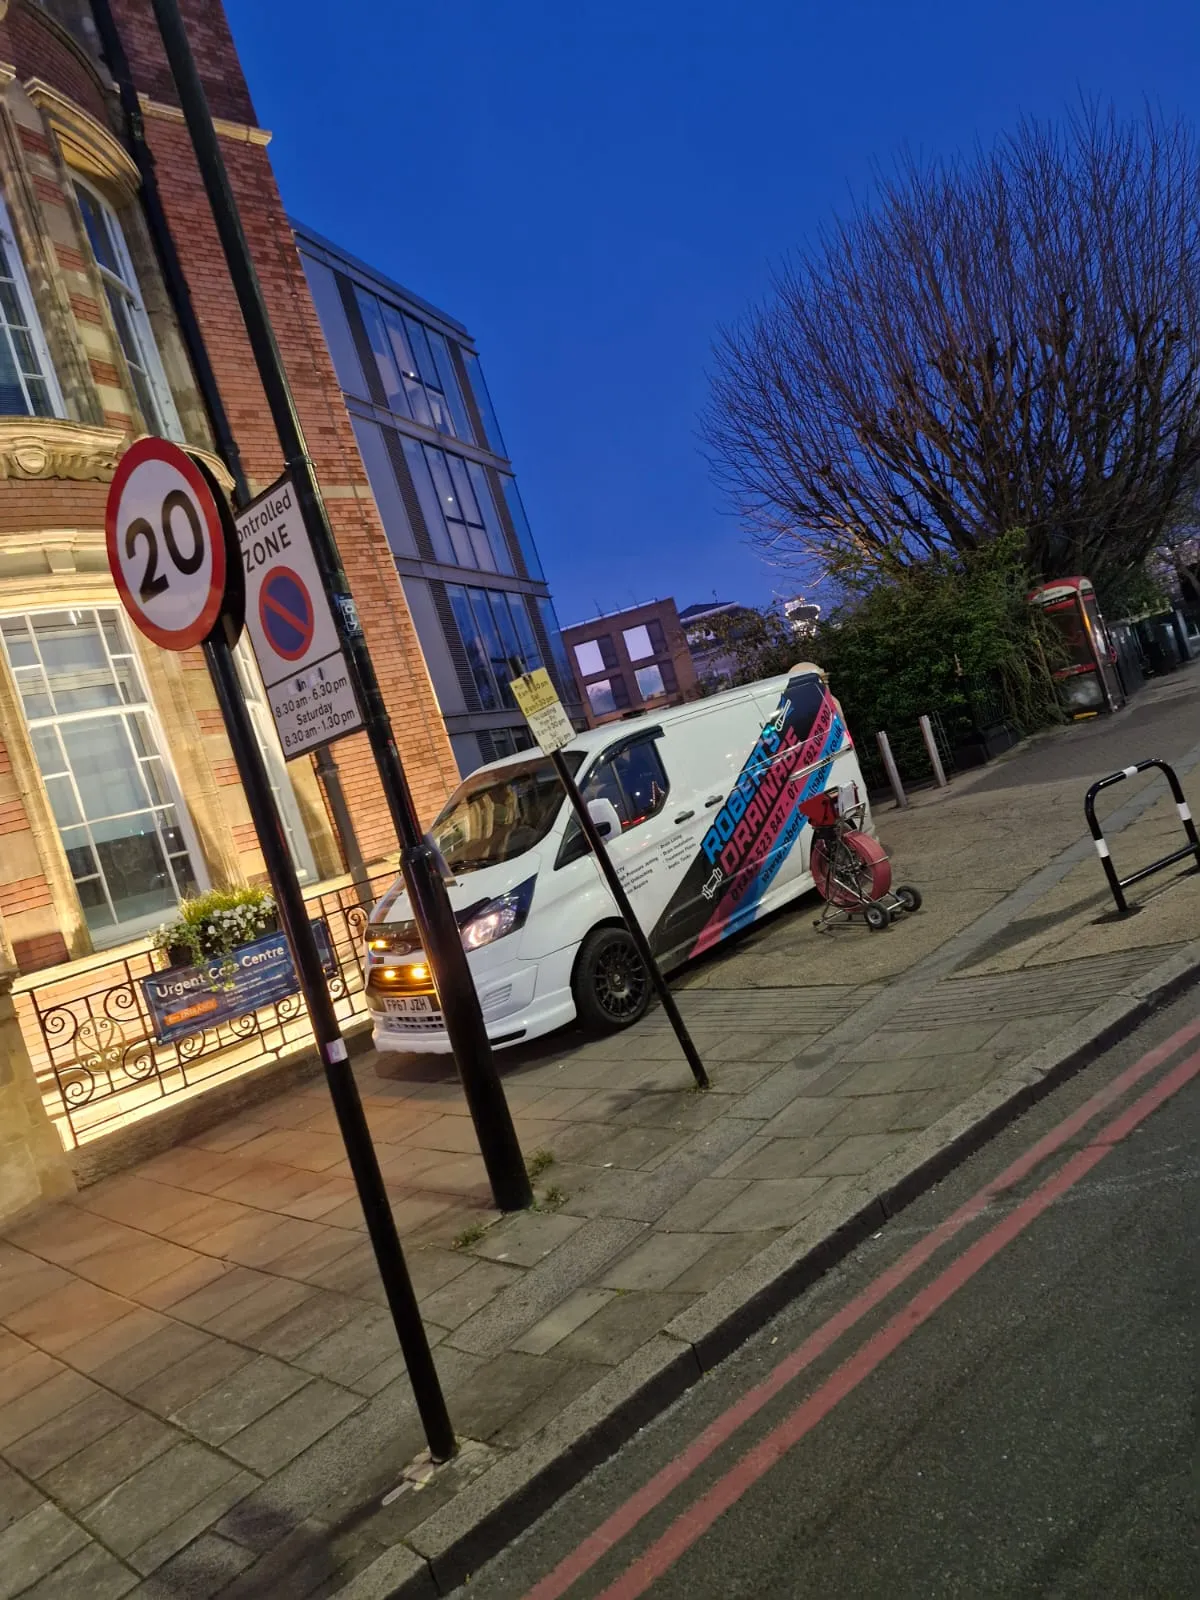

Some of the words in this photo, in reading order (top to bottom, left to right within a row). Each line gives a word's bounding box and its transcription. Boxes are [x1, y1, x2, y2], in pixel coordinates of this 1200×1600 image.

[237, 488, 292, 543] ontrolled
[125, 489, 205, 604] 20
[242, 523, 292, 573] ZONE
[296, 702, 333, 726] Saturday
[701, 720, 781, 864] ROBERTS
[720, 725, 798, 875] DRAINAGE
[770, 806, 786, 832] 847
[156, 973, 206, 998] Urgent
[241, 946, 285, 967] Centre
